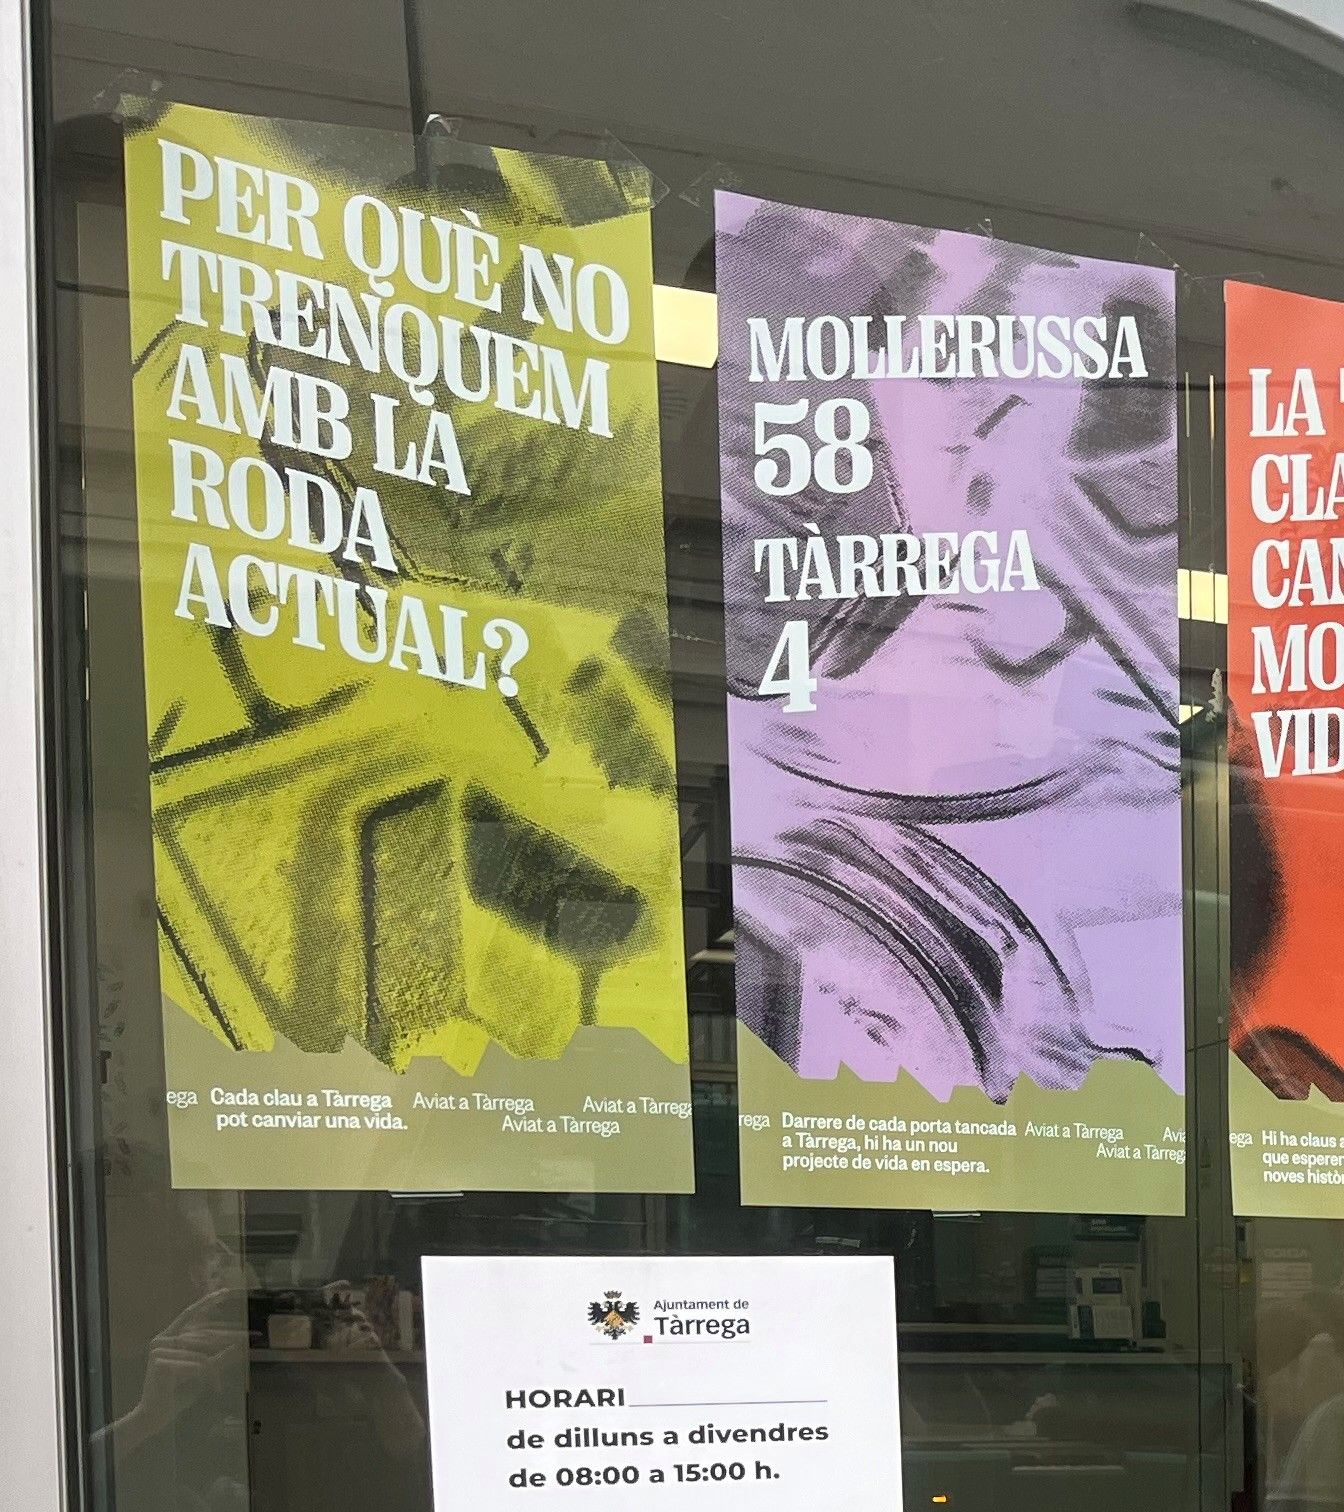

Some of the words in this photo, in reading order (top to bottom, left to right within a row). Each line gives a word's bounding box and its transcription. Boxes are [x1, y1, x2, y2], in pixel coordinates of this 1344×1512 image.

[158, 138, 323, 260] PER
[344, 194, 500, 312] QUÈ
[520, 243, 630, 346] NO
[161, 240, 613, 440] TRENQUEM
[747, 315, 1148, 383] MOLLERUSSA
[1249, 368, 1326, 437] LA
[166, 344, 353, 461] AMB
[370, 392, 473, 496] LA
[753, 398, 874, 495] 58
[169, 439, 397, 572] RODA
[755, 523, 1041, 603] TÀRREGA
[174, 542, 530, 697] ACTUAL?
[757, 620, 817, 713] 4
[211, 1088, 259, 1106] Cada
[264, 1089, 302, 1107] clau
[307, 1094, 318, 1107] a
[321, 1090, 392, 1112] Tàrrega
[413, 1092, 455, 1110] Aviat
[459, 1098, 469, 1110] a
[472, 1093, 534, 1115] Tàrrega
[217, 1112, 248, 1130] pot
[252, 1112, 321, 1128] canviar
[325, 1116, 361, 1128] una
[364, 1113, 407, 1130] vida.
[782, 1112, 842, 1130] Darrere
[846, 1115, 864, 1131] de
[869, 1117, 906, 1132] cada
[911, 1120, 952, 1136] porta
[955, 1120, 1016, 1136] tancada
[1025, 1122, 1059, 1138] Aviat
[1063, 1128, 1071, 1138] a
[1073, 1123, 1124, 1143] Tàrrega
[782, 1136, 792, 1148] a
[796, 1132, 860, 1153] Tàrrega,
[865, 1135, 878, 1151] hi
[883, 1136, 901, 1151] ha
[906, 1140, 925, 1152] un
[929, 1141, 957, 1153] nou
[1262, 1130, 1276, 1145] Hi
[1280, 1131, 1298, 1146] ha
[1300, 1132, 1336, 1148] claus
[782, 1153, 848, 1172] projecte
[852, 1154, 871, 1169] de
[876, 1154, 908, 1170] vida
[911, 1160, 930, 1171] en
[934, 1160, 990, 1175] espera.
[1263, 1154, 1289, 1166] que
[1264, 1170, 1304, 1183] noves
[654, 1298, 729, 1312] Ajuntament
[733, 1298, 749, 1310] de
[655, 1313, 750, 1339] Tàrrega
[506, 1388, 625, 1409] HORARI
[507, 1429, 544, 1449] de
[554, 1427, 654, 1448] dilluns
[664, 1430, 679, 1445] a
[689, 1423, 829, 1445] divendres
[509, 1468, 546, 1488] de
[556, 1466, 640, 1486] 08:00
[649, 1468, 665, 1484] a
[674, 1462, 745, 1483] 15:00
[755, 1461, 780, 1480] h.
